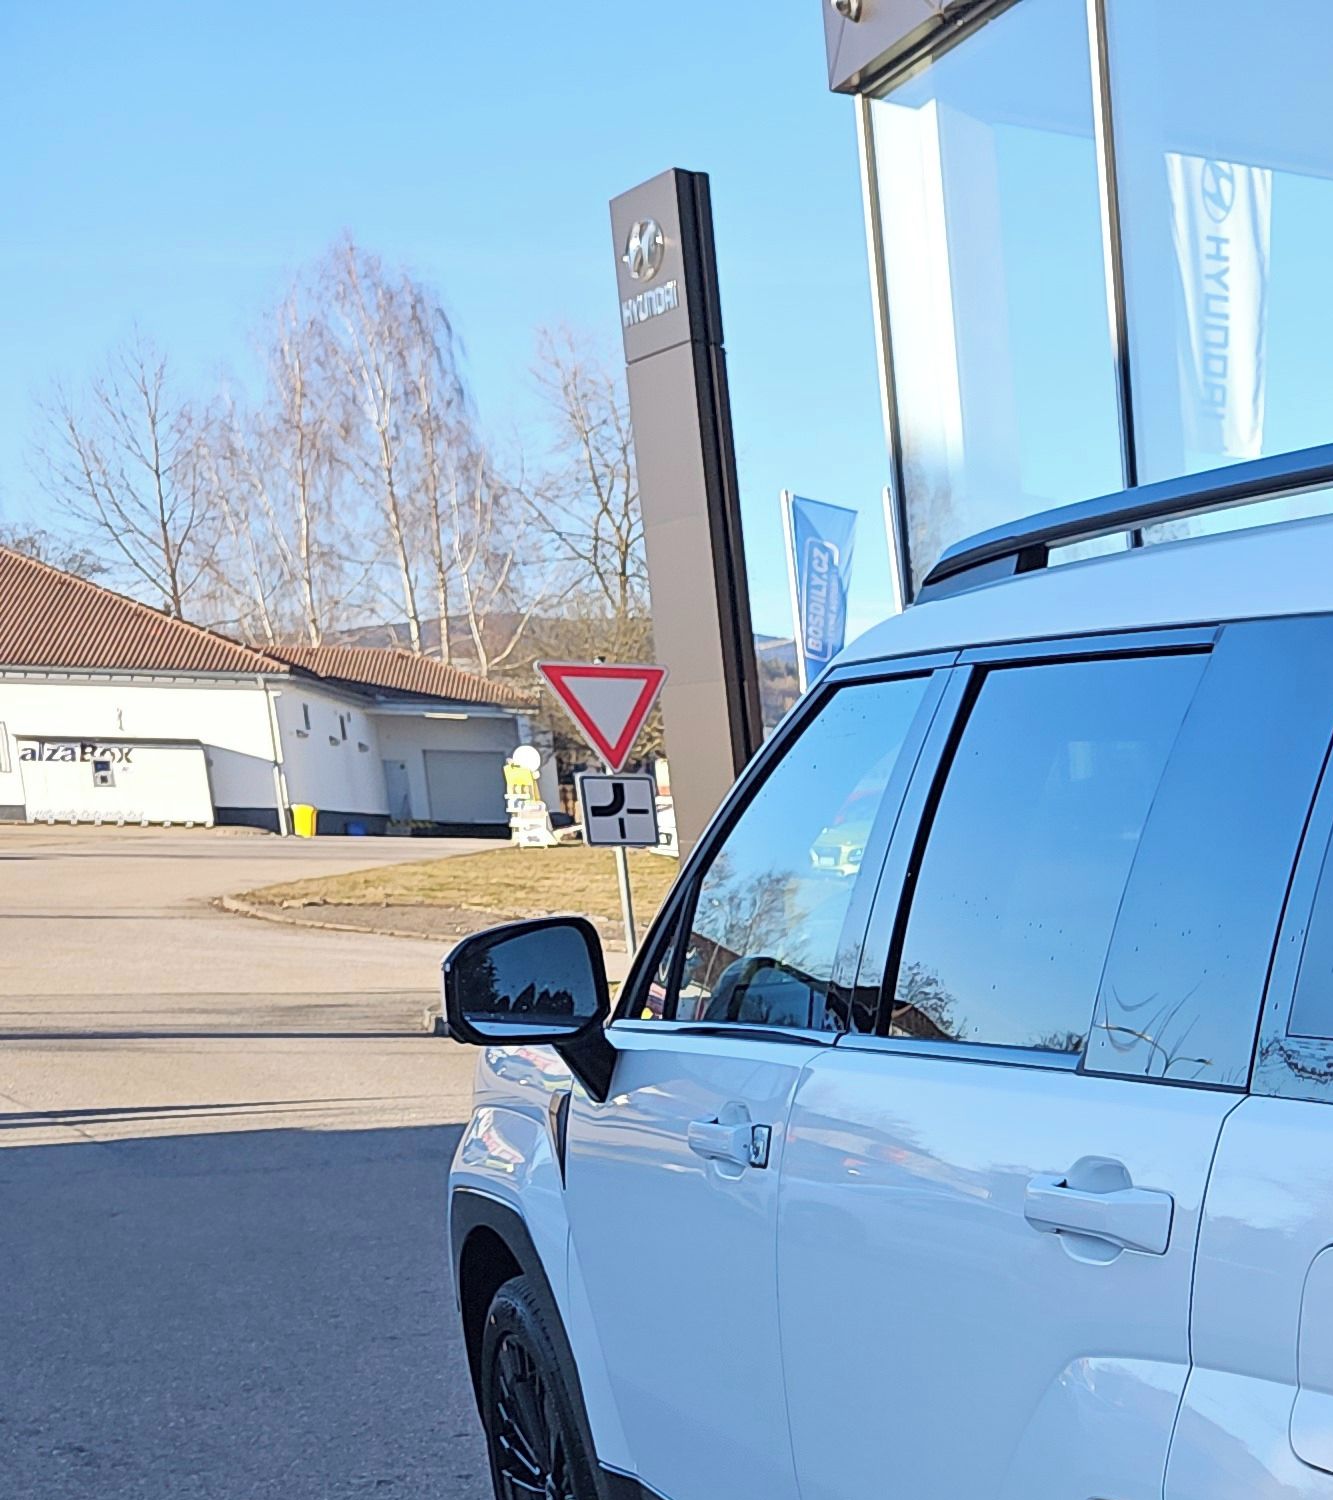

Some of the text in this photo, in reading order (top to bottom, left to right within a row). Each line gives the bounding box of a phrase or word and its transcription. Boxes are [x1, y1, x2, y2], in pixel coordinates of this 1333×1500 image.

[621, 279, 679, 328] HYUNDAI
[1203, 234, 1230, 420] HYUNDAI
[20, 740, 133, 763] alzaBox
